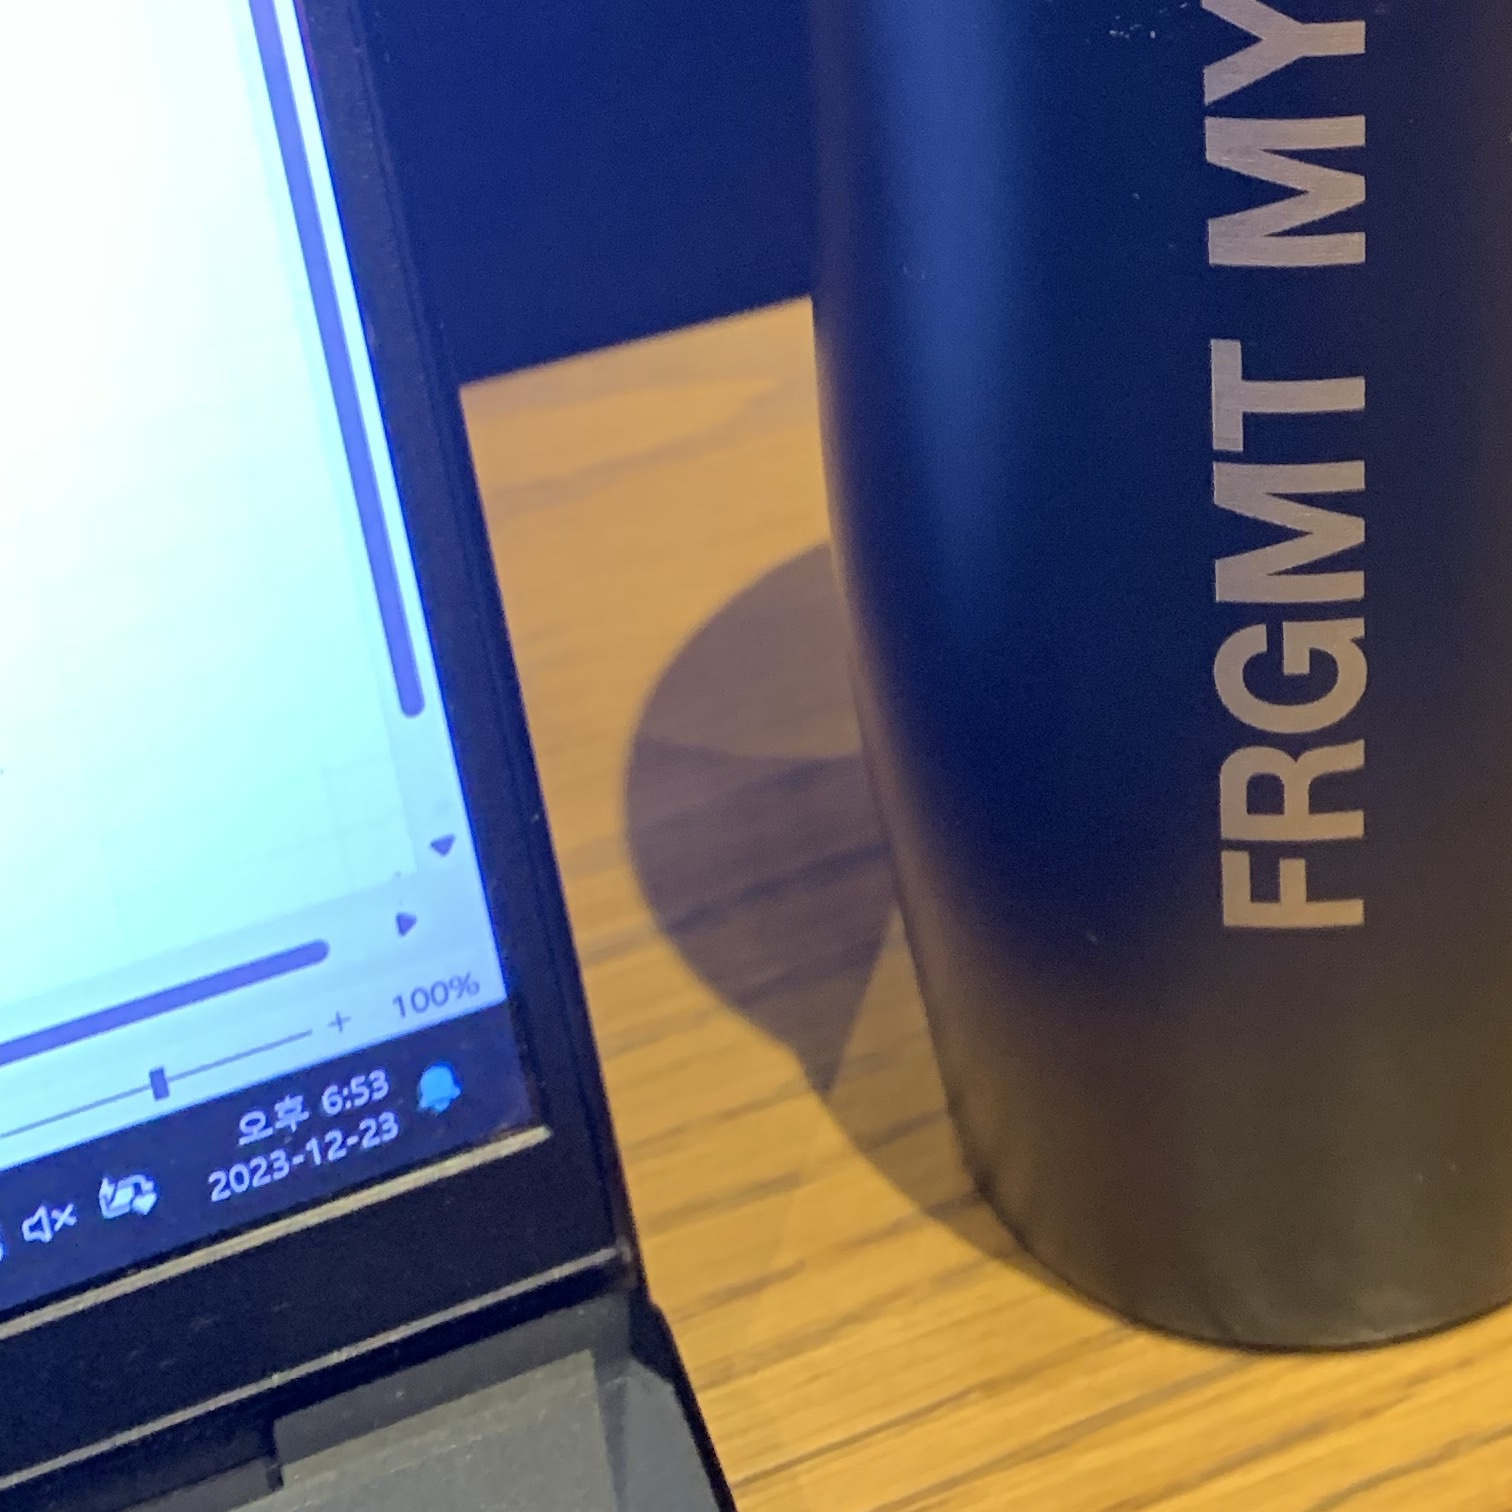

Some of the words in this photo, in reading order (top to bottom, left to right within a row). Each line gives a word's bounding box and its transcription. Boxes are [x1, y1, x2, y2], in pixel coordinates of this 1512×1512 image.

[1210, 338, 1368, 928] FRGMT
[392, 971, 480, 1018] 100%
[238, 1094, 311, 1146] 오후
[321, 1069, 390, 1116] 6:53
[208, 1111, 399, 1202] 2023-12-23
